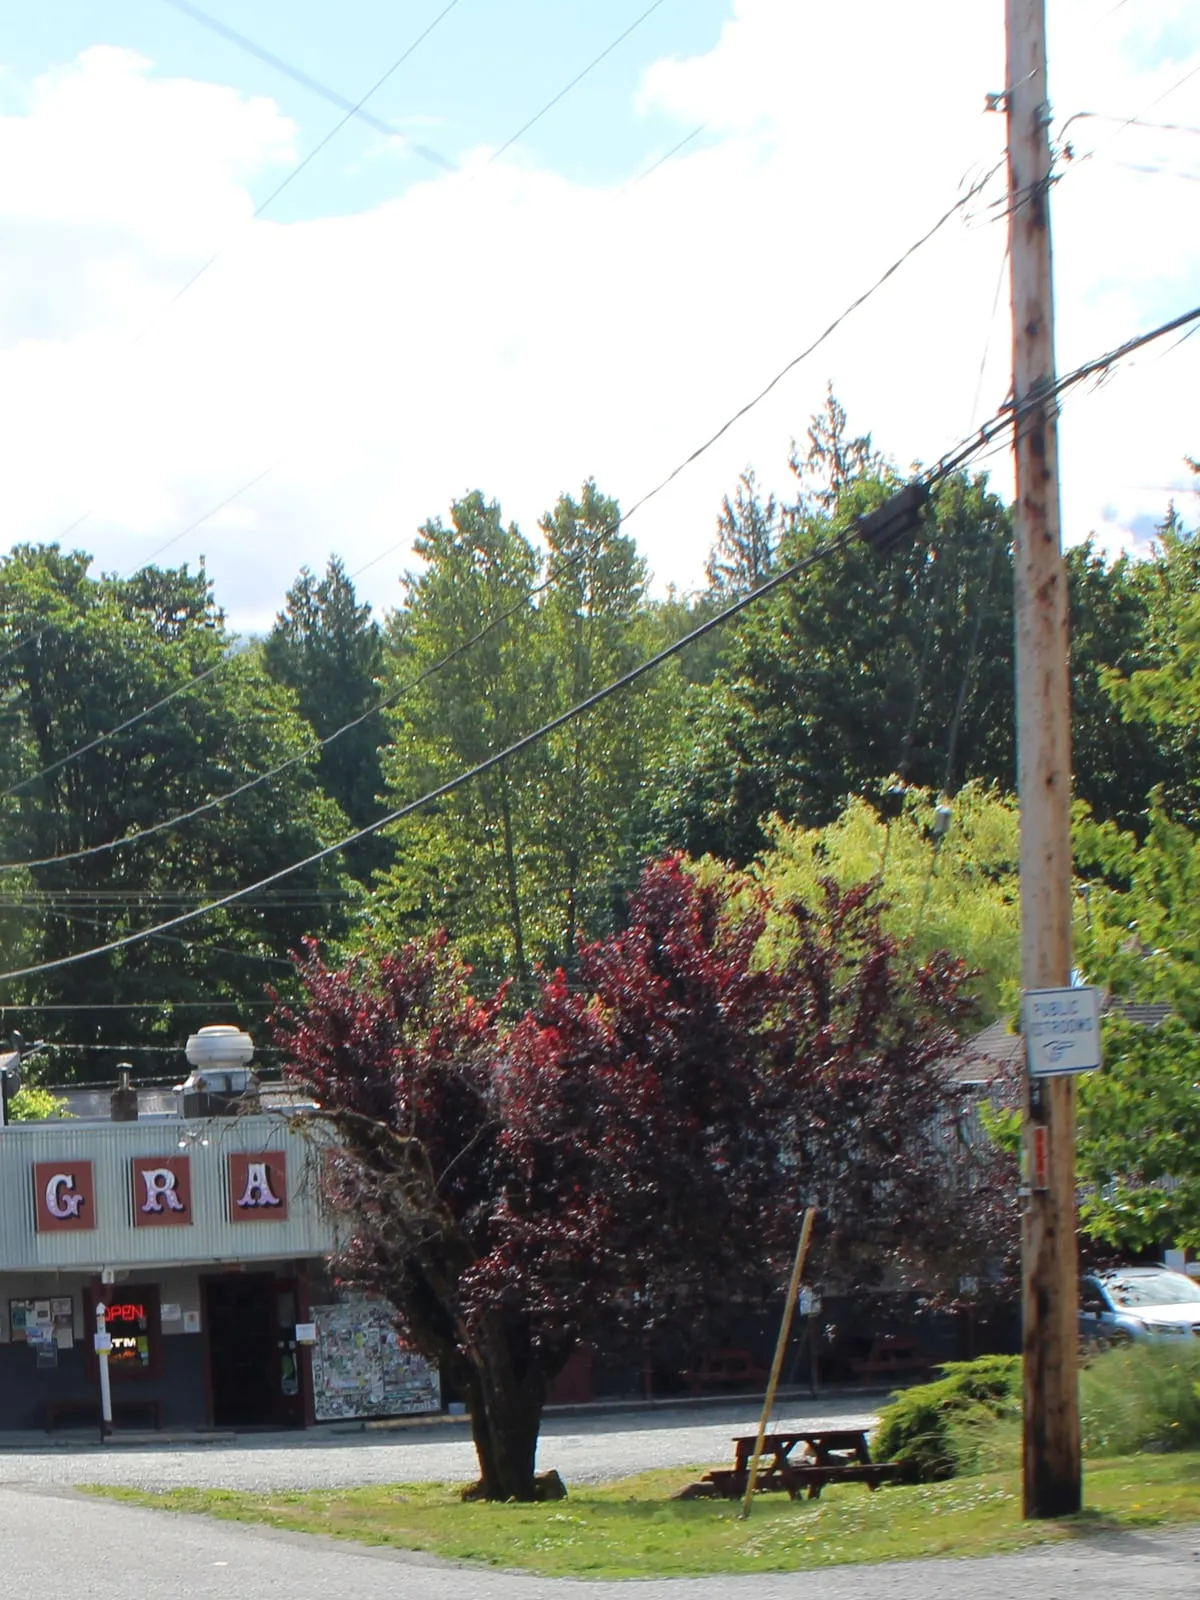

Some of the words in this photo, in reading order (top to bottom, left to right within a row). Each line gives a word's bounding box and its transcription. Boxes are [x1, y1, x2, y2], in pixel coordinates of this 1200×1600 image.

[1033, 1000, 1079, 1017] PUBLIC
[1029, 1017, 1094, 1037] ESTROOMS
[109, 1337, 136, 1348] TM
